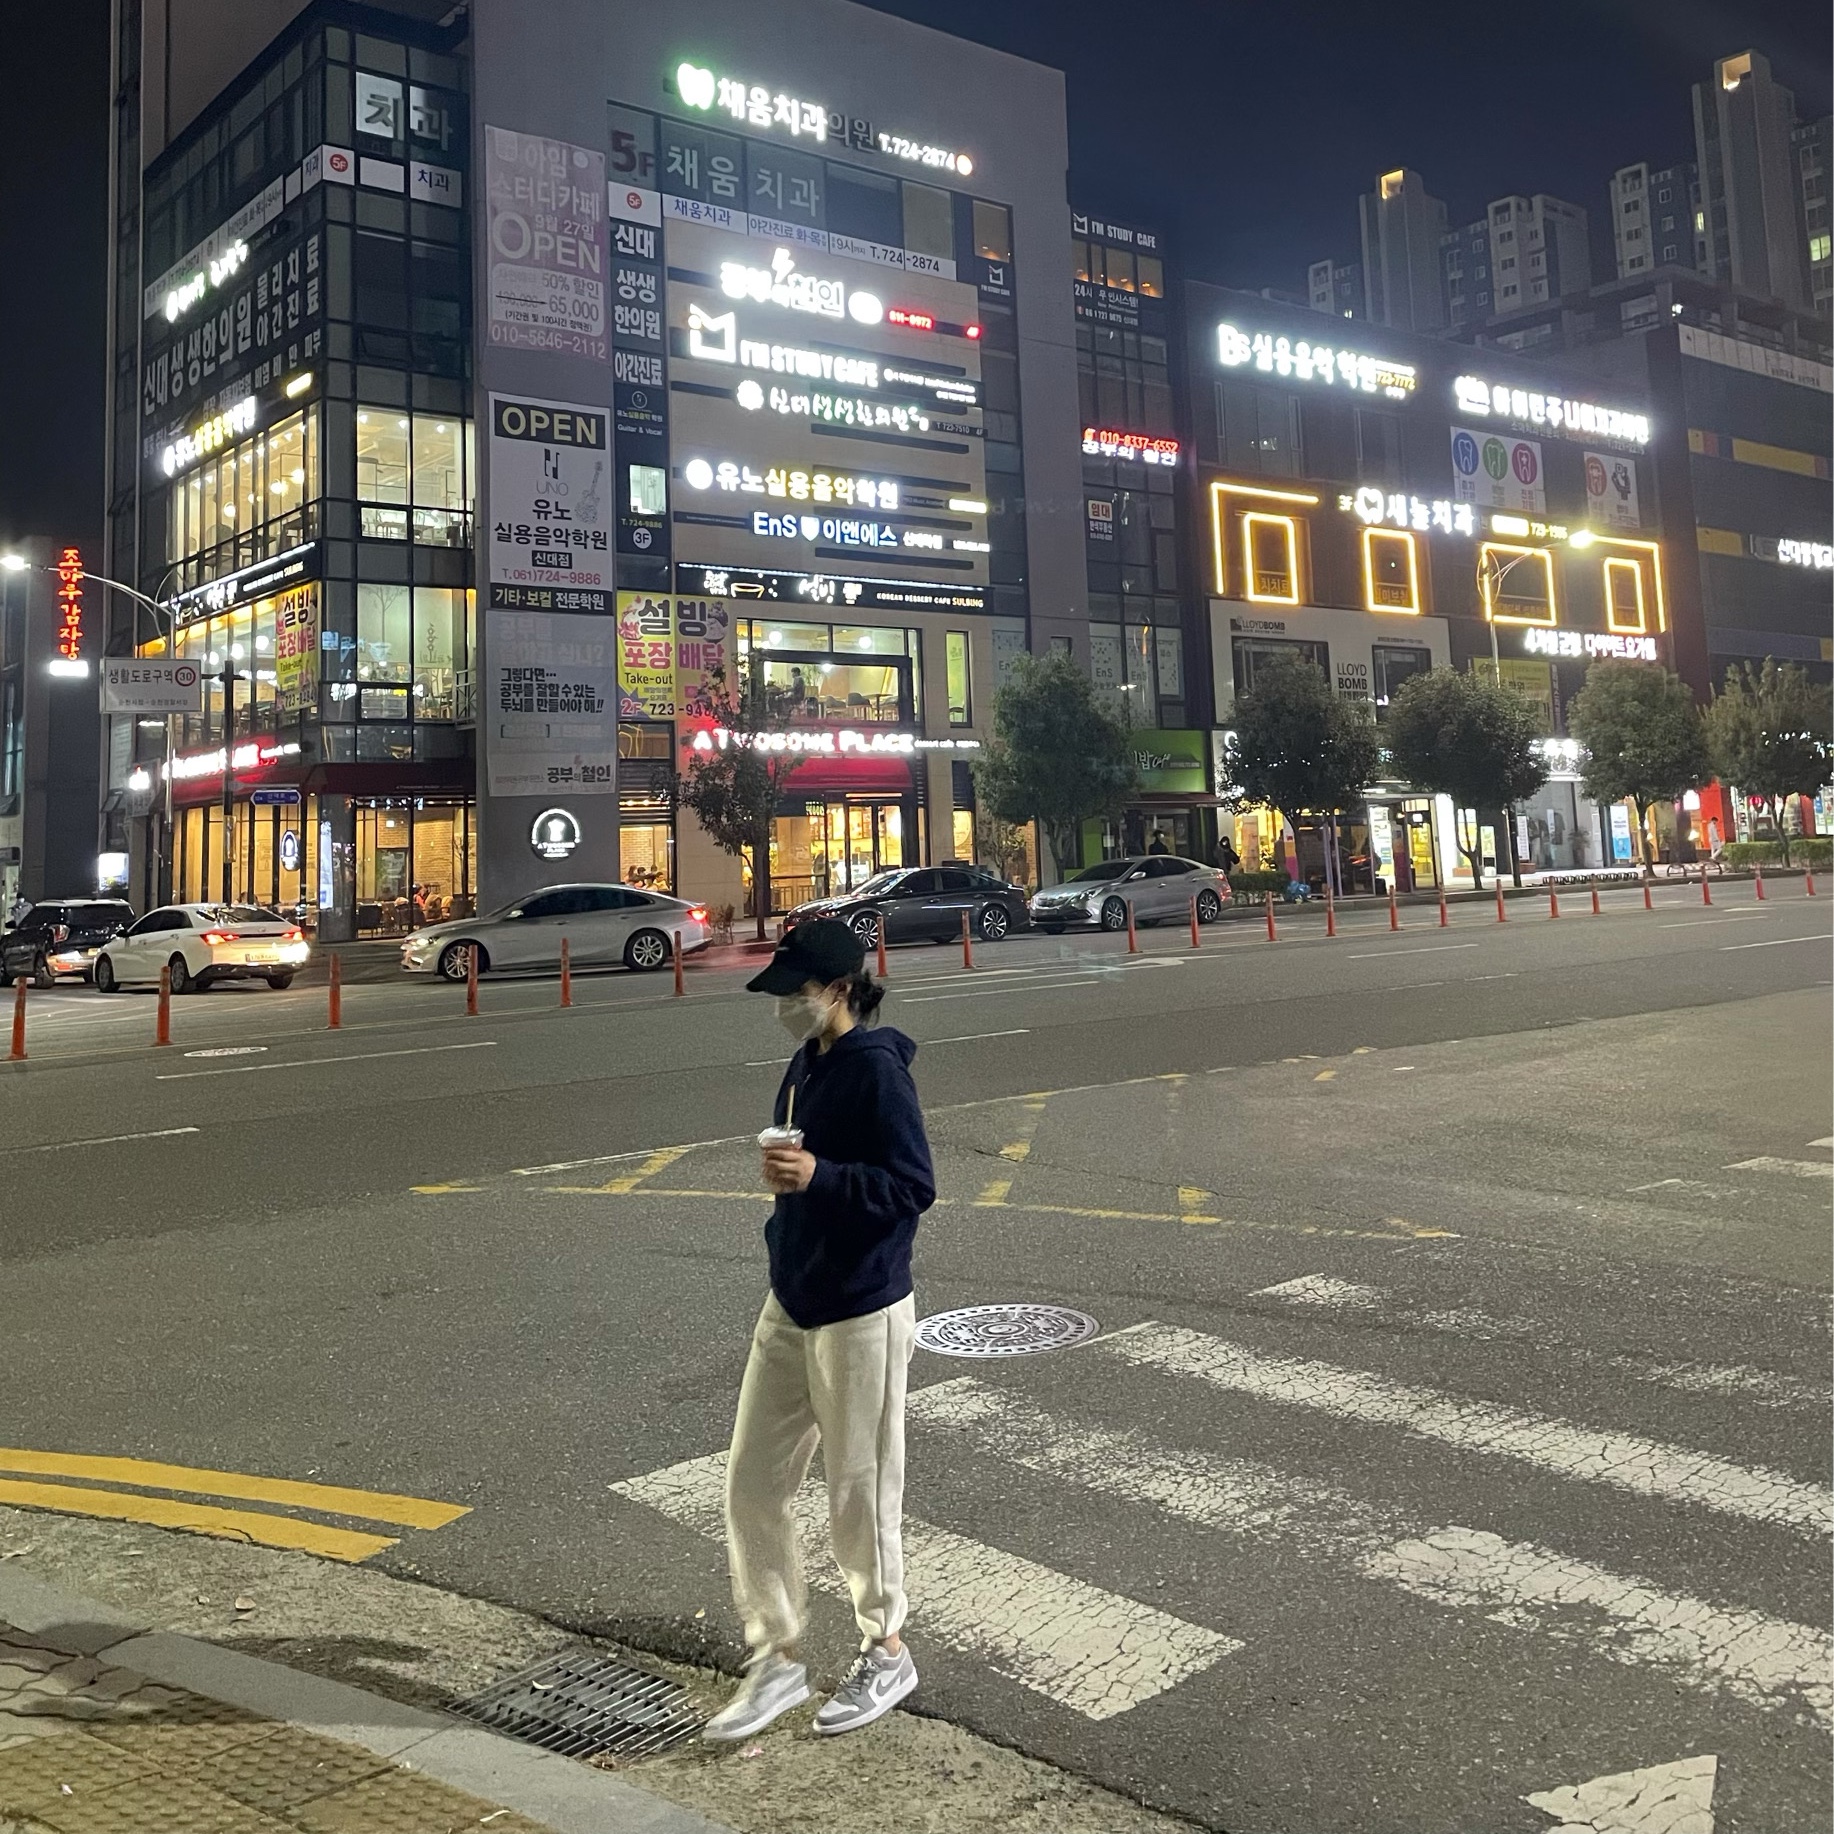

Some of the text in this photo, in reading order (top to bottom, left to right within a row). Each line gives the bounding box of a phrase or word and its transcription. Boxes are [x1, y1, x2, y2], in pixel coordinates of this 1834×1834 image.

[365, 93, 453, 150] 치과
[331, 156, 347, 170] 5F
[611, 130, 654, 177] 5F
[418, 168, 449, 192] 치과
[666, 145, 820, 217] 채움치과
[491, 173, 600, 223] 스터디카페
[628, 194, 642, 208] 5F
[674, 198, 731, 226] 채움치과
[563, 218, 595, 242] 27일
[750, 217, 794, 238] 야간진료
[1107, 224, 1134, 243] STUDY
[1136, 231, 1157, 249] CAFE
[492, 210, 601, 275] OPEN
[614, 224, 655, 260] 신대
[541, 273, 570, 292] 50%
[572, 277, 600, 300] 할인
[615, 268, 657, 304] 생생
[548, 294, 600, 322] 65,000
[614, 304, 661, 340] 한의원
[614, 351, 663, 386] 야간진료
[501, 405, 597, 445] OPEN
[536, 480, 569, 497] UNO
[532, 498, 572, 521] 유노
[494, 522, 608, 551] 실용음악학원
[634, 532, 650, 545] 3F
[753, 510, 798, 539] EnS
[823, 519, 899, 548] 이앤에스
[533, 552, 570, 568] 신대점
[501, 567, 602, 586] T.061)724-9886
[58, 547, 84, 660] 조마루감자탕
[555, 593, 605, 610] 전문학원
[951, 596, 984, 609] SULBING
[638, 599, 708, 638] 설빙
[623, 641, 673, 670] 포장
[108, 667, 174, 686] 생활도로구역
[179, 671, 193, 682] 30
[624, 671, 673, 686] Take-out
[1095, 667, 1113, 679] EnS
[1336, 662, 1368, 678] LLOYD
[500, 683, 535, 699] 공부를
[573, 684, 596, 699] 있는
[1338, 677, 1368, 691] BOMB
[500, 698, 535, 714] 두뇌를
[620, 698, 643, 716] 2F
[692, 730, 713, 750] A
[838, 729, 915, 753] PLACE
